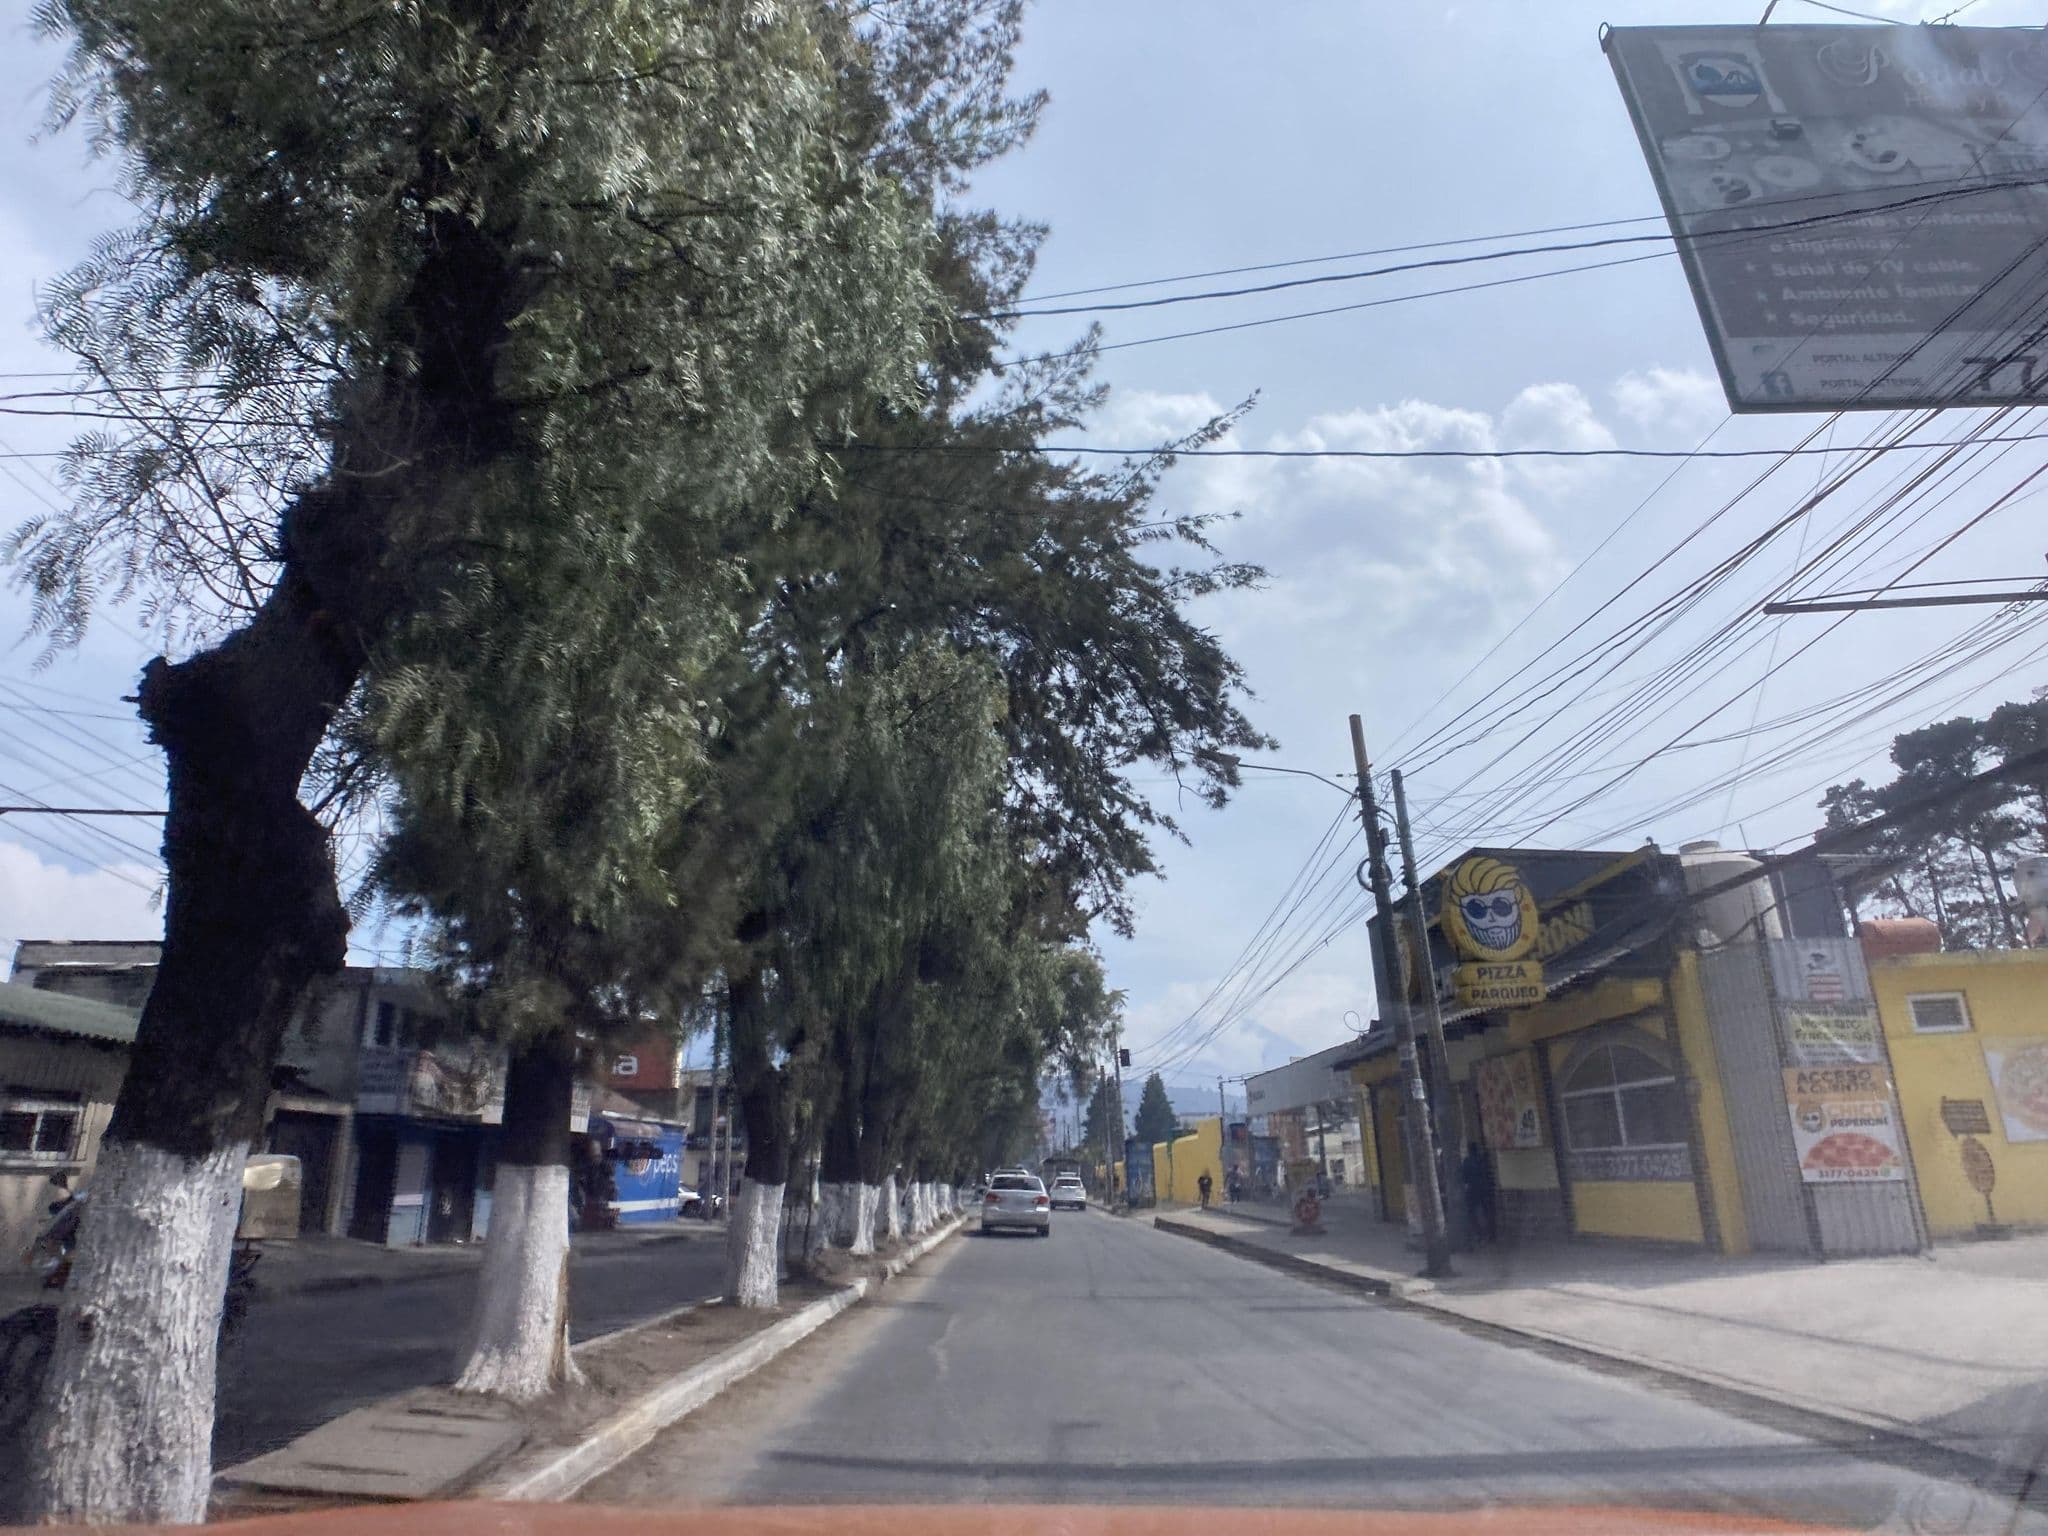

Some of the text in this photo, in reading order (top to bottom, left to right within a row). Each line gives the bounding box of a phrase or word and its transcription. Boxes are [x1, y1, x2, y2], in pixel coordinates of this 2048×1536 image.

[1771, 259, 1834, 277] Señal
[1842, 259, 1870, 275] de
[1877, 259, 1904, 274] TV
[1782, 284, 1888, 301] Ambiente
[1812, 353, 1857, 363] PORTAL
[1476, 965, 1527, 980] PIZZA
[1471, 985, 1538, 1000] PARQUEO
[1796, 1069, 1872, 1085] ACCESO
